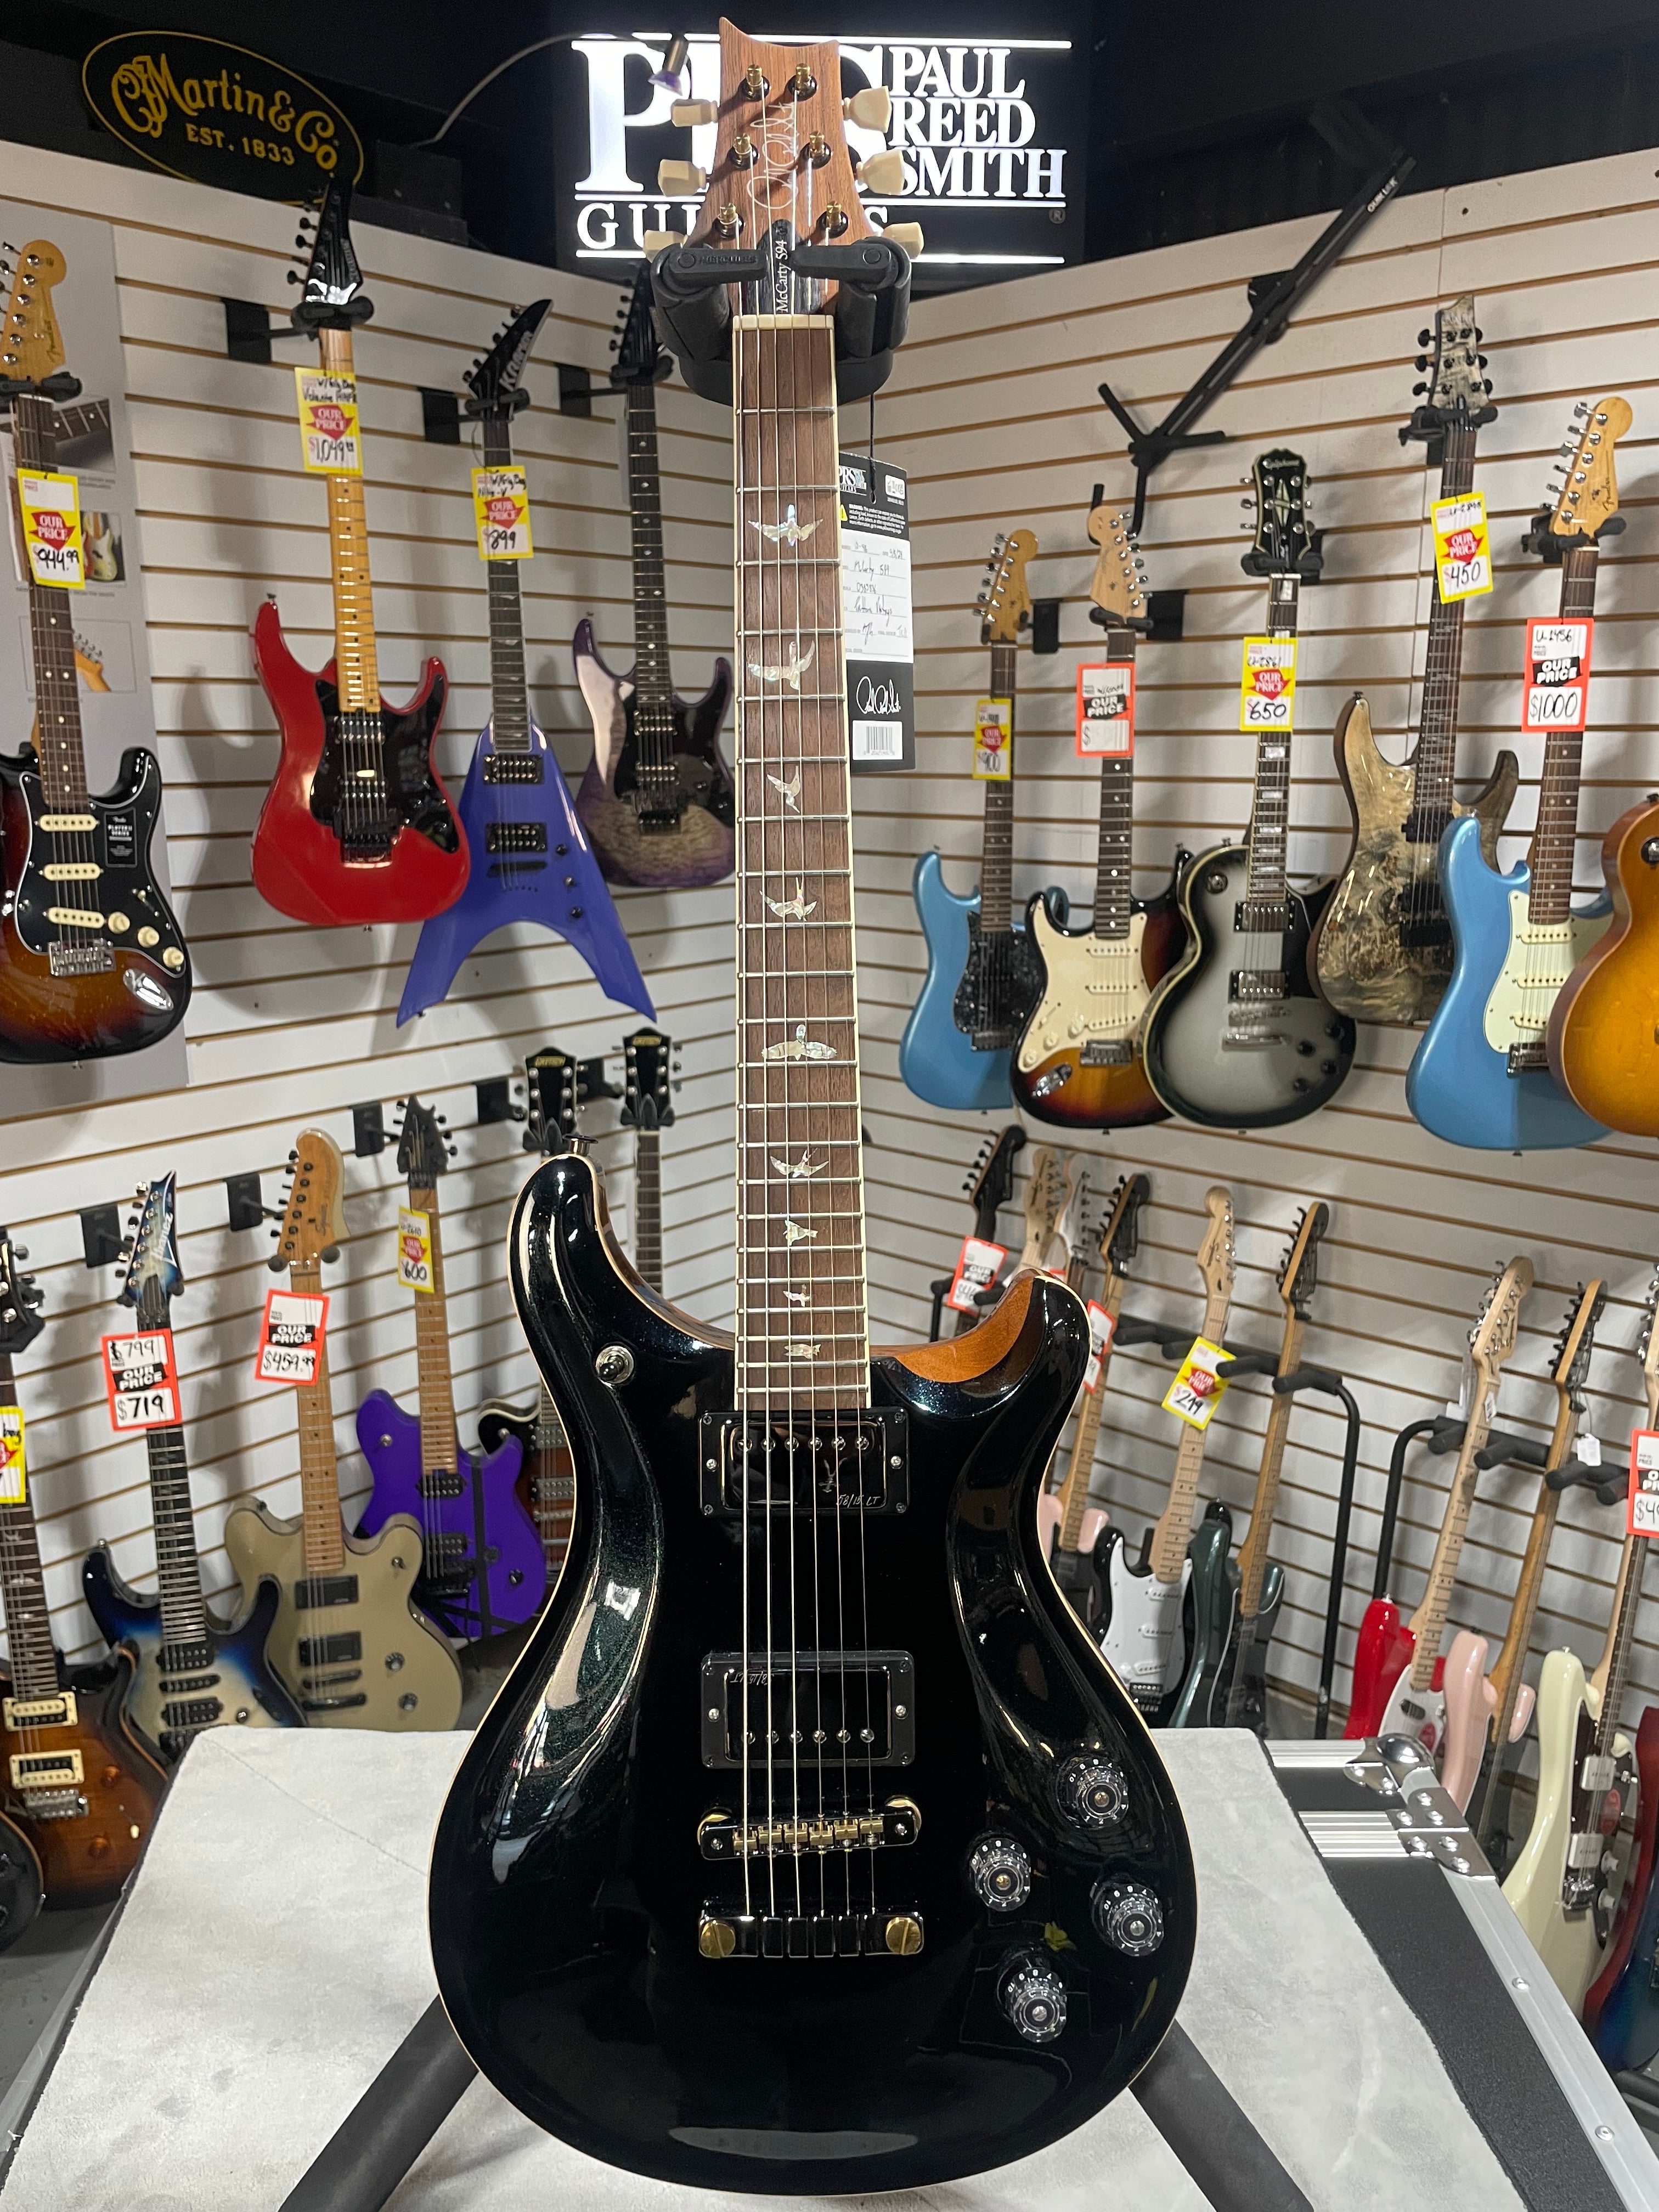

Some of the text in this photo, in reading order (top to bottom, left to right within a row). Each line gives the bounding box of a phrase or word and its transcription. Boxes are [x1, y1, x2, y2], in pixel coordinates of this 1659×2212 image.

[889, 47, 1025, 99] PAUL
[888, 97, 1036, 148] REED
[187, 123, 296, 165] EST. 1833
[775, 239, 791, 313] McCarty 594
[317, 408, 342, 421] OUR
[491, 501, 514, 511] OUR
[40, 516, 64, 528] OUR
[1451, 532, 1474, 545] OUR
[1449, 541, 1479, 558] PRICE
[1542, 658, 1571, 673] OUR
[1259, 673, 1281, 682] OUR
[1537, 667, 1578, 685] PRICE
[1255, 681, 1284, 692] PRICE
[1091, 696, 1118, 708] OUR
[1530, 692, 1578, 722] $1000
[1087, 704, 1125, 718] PRICE
[969, 1266, 991, 1275] OUR
[277, 1325, 307, 1335] OUR
[272, 1333, 313, 1344] PRICE
[123, 1364, 154, 1380] OUR
[1194, 1370, 1215, 1387] OUR
[119, 1372, 163, 1391] PRICE
[117, 1394, 164, 1420] $719
[866, 1496, 881, 1506] LT
